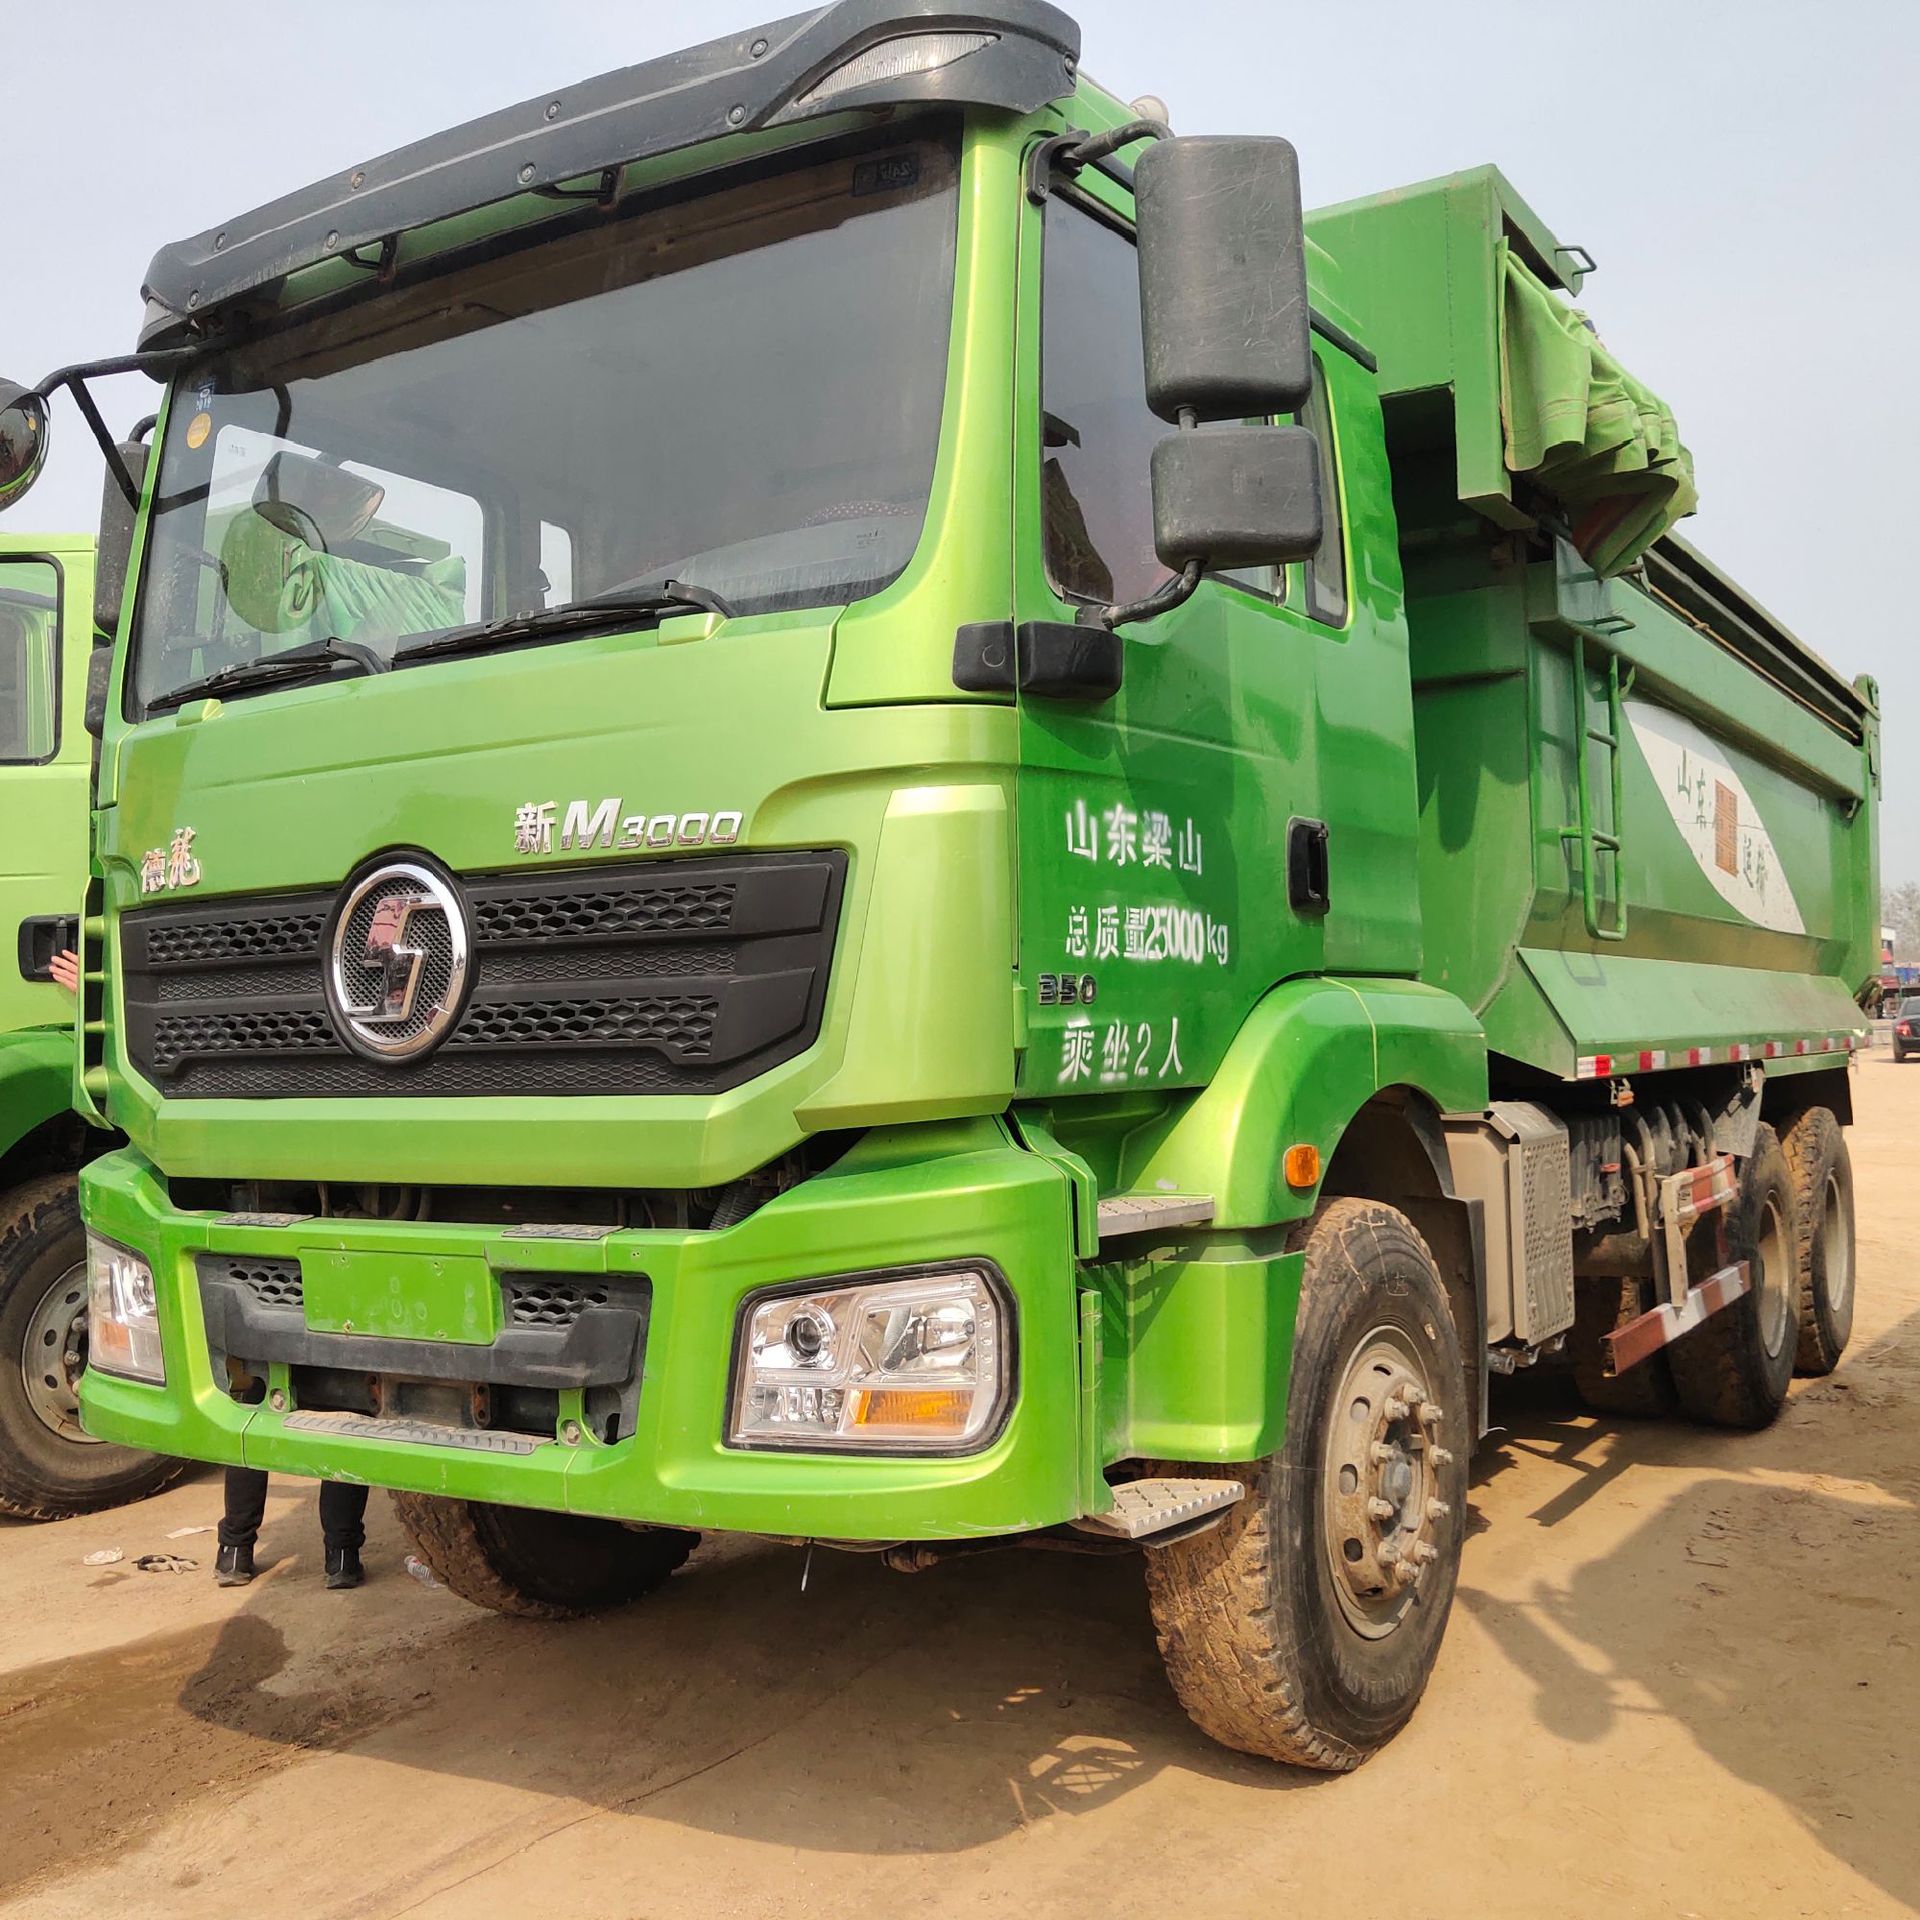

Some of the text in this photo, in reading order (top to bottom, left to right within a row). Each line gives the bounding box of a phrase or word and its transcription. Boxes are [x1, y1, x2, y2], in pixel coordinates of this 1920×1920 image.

[1065, 799, 1202, 876] 山东梁山
[1038, 972, 1097, 1005] 350
